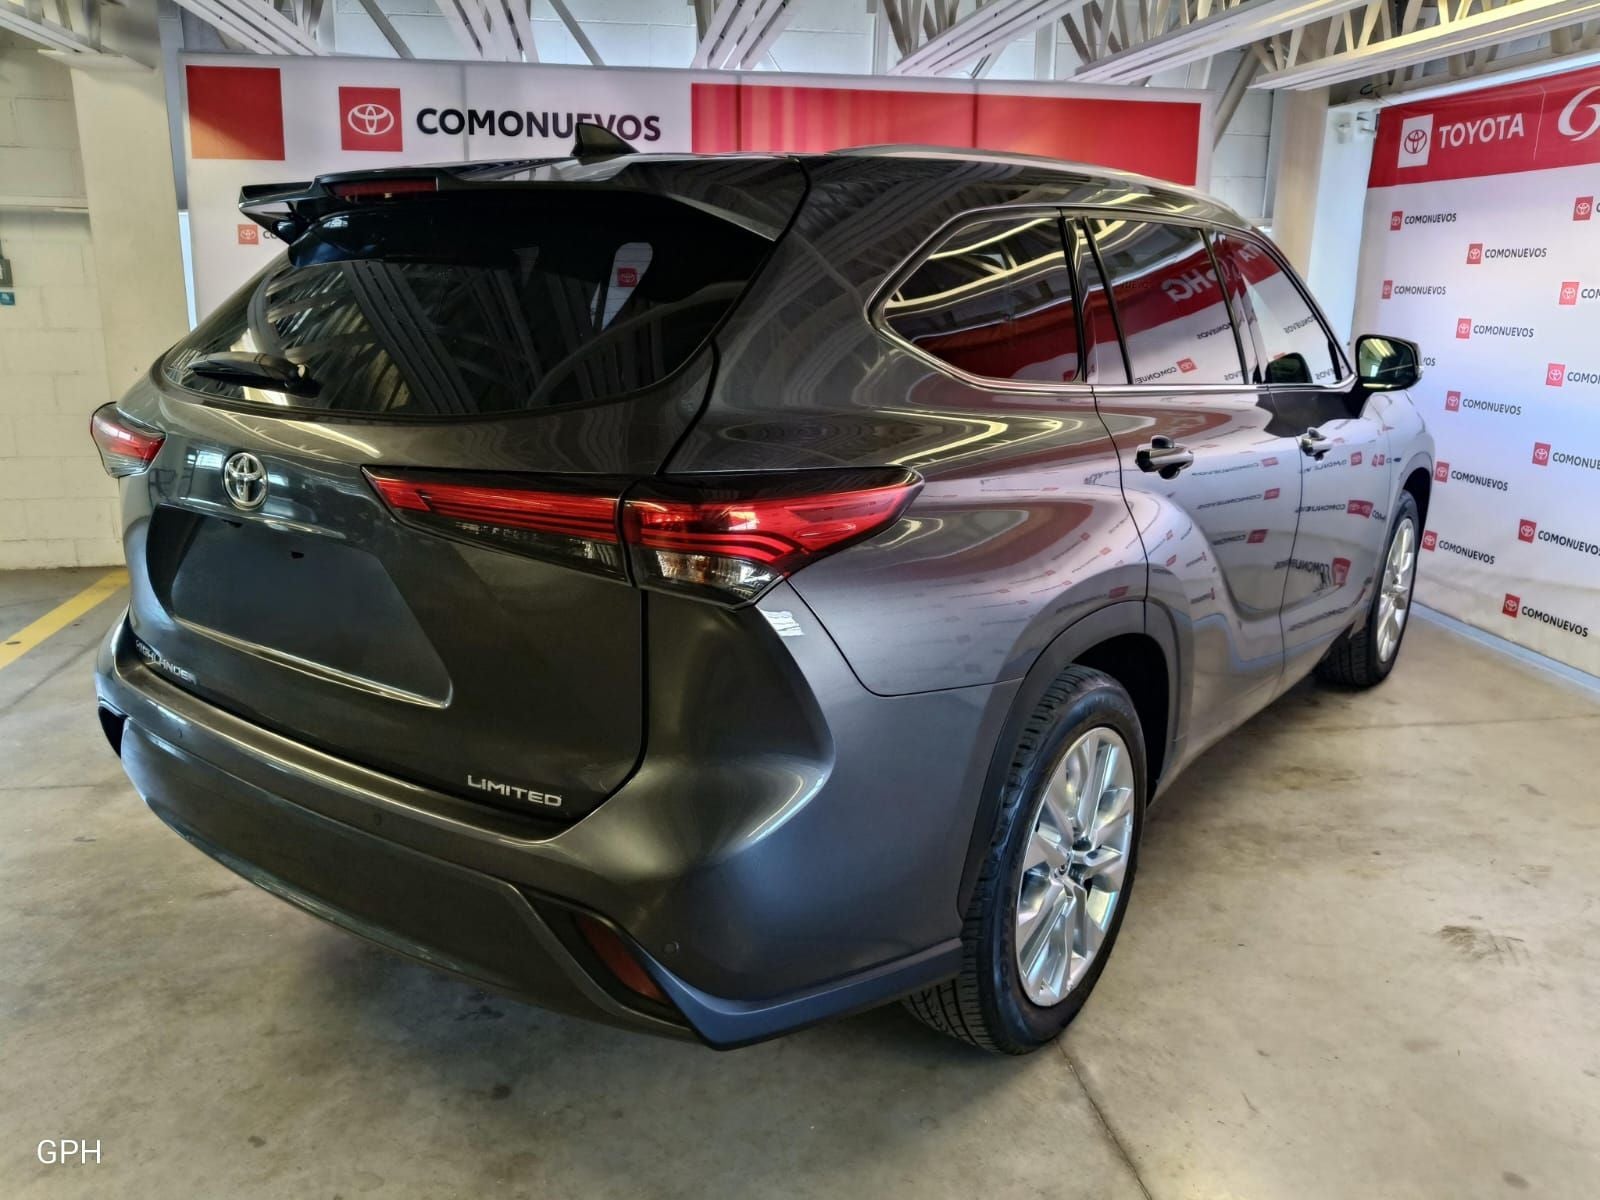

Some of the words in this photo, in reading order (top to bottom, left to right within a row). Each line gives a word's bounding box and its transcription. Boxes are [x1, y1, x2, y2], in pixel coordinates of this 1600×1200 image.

[1439, 113, 1524, 149] TOYOTA
[1404, 213, 1457, 224] COMONUEVOS
[1484, 248, 1547, 258] COMONUEVOS
[1394, 285, 1447, 296] COMONUEVOS
[1473, 325, 1534, 338] COMONUEVOS
[1462, 398, 1522, 415] COMONUEVOS
[1451, 470, 1508, 491] COMONUEVOS
[1438, 540, 1495, 565] COMONUEVOS
[1521, 606, 1588, 637] COMONUEVOS
[467, 774, 562, 806] LIMITED
